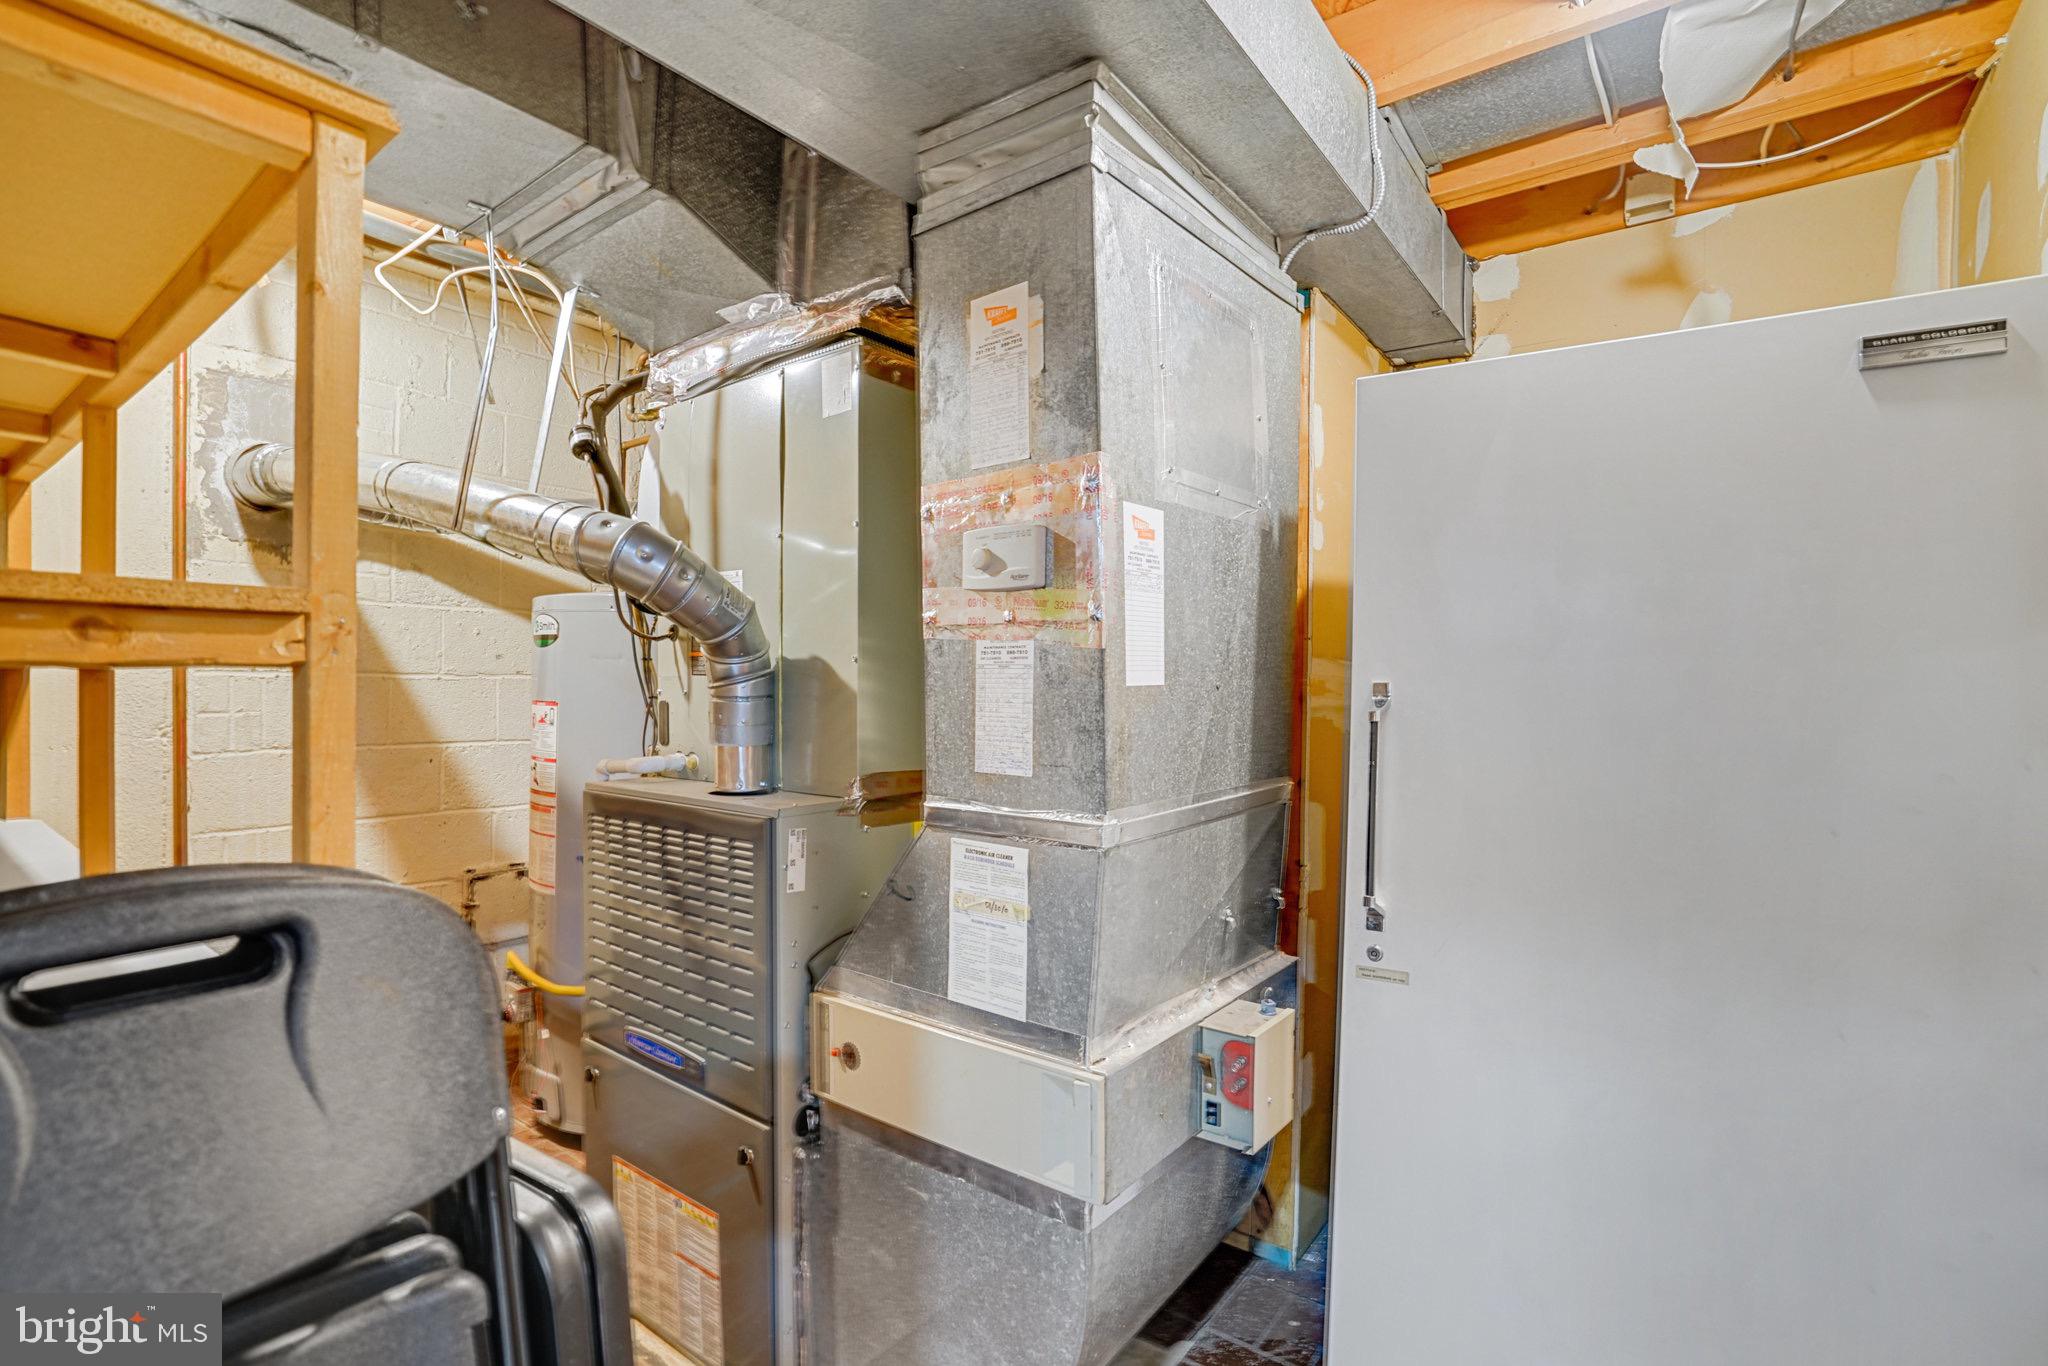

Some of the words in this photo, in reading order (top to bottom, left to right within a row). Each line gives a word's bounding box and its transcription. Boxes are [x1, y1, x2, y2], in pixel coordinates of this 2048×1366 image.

[1872, 336, 1916, 346] SEARS
[1920, 324, 1995, 340] COLDSPOT
[1054, 600, 1076, 610] 324A
[965, 848, 988, 857] ELECTRONIC
[995, 853, 1014, 861] CLEANER
